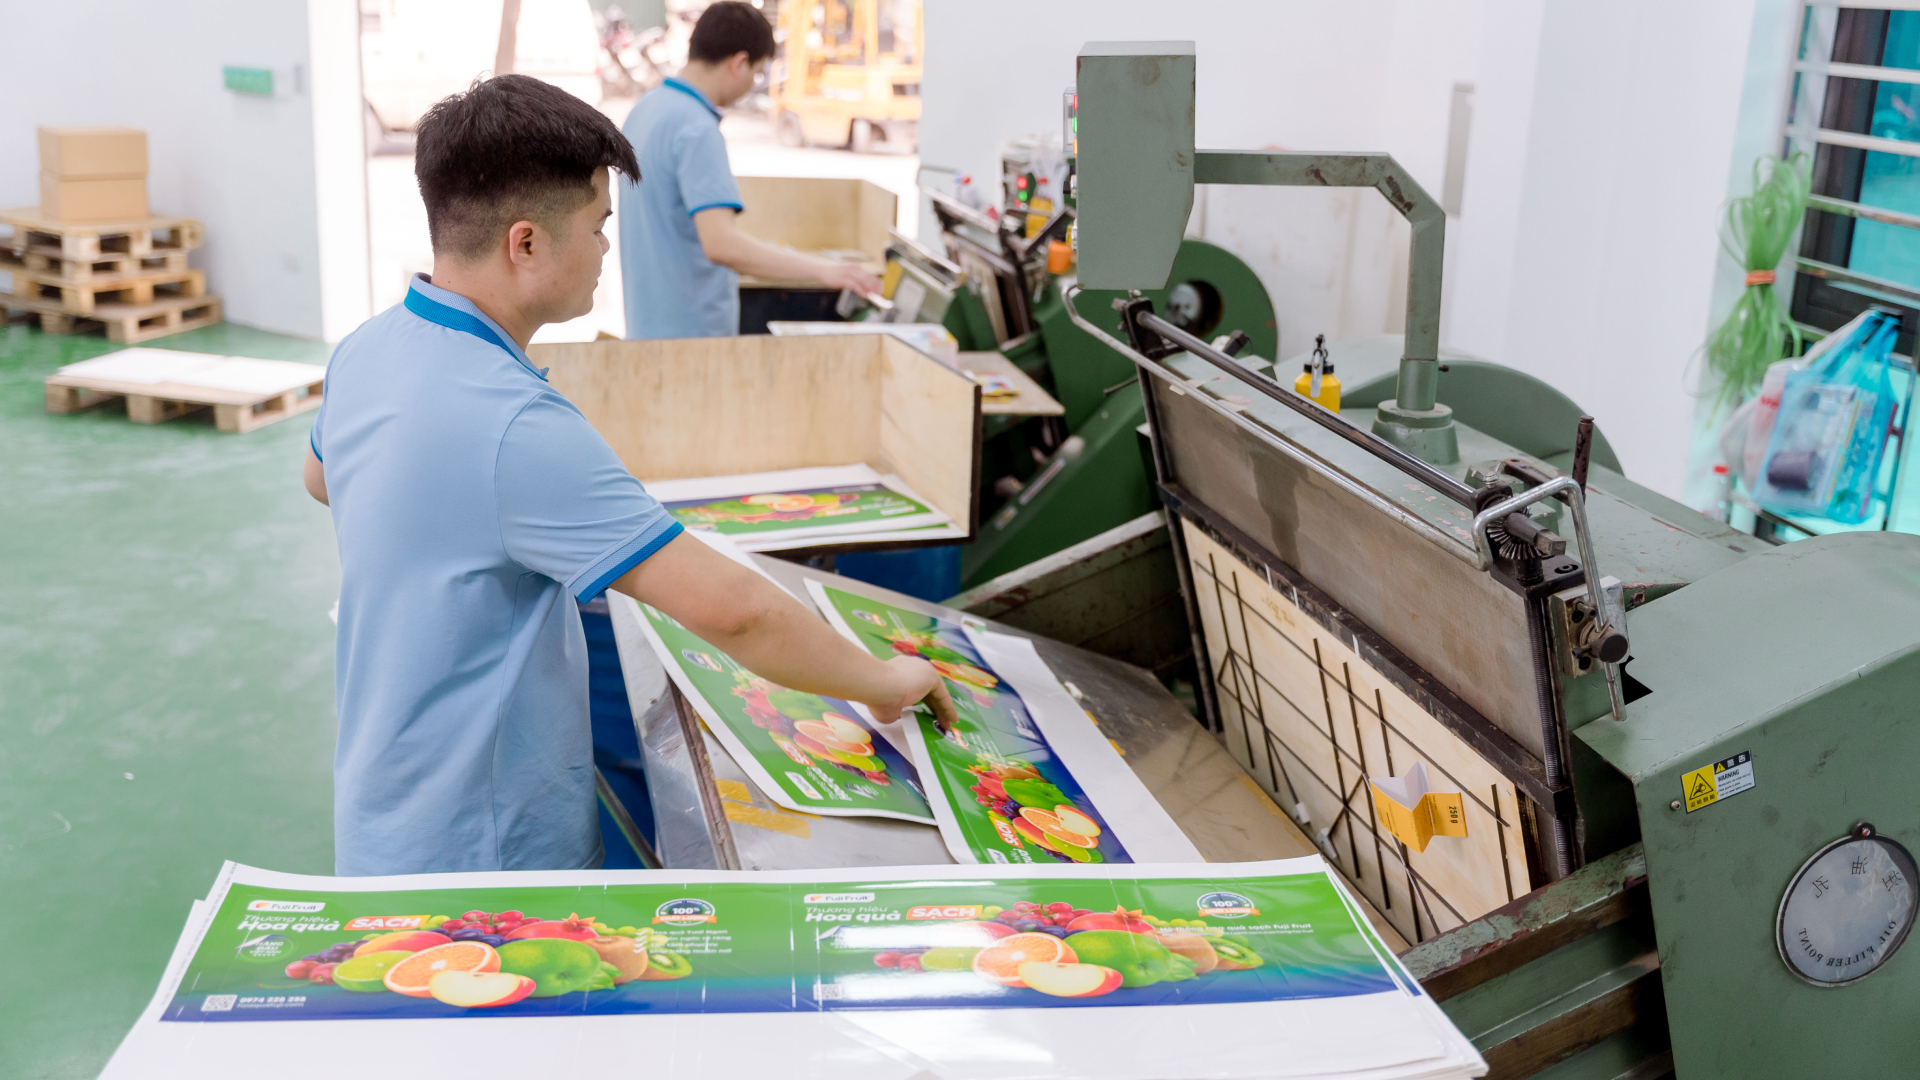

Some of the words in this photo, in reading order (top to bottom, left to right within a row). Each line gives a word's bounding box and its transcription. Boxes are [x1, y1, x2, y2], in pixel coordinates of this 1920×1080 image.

[1717, 769, 1740, 782] WARNING
[1449, 806, 1459, 818] 250
[245, 914, 297, 923] Thương
[805, 912, 852, 922] Hoa
[855, 911, 901, 923] quả
[911, 907, 977, 919] SẠCH
[237, 920, 290, 930] Hoa
[291, 920, 341, 933] quả
[351, 917, 422, 930] SẠCH
